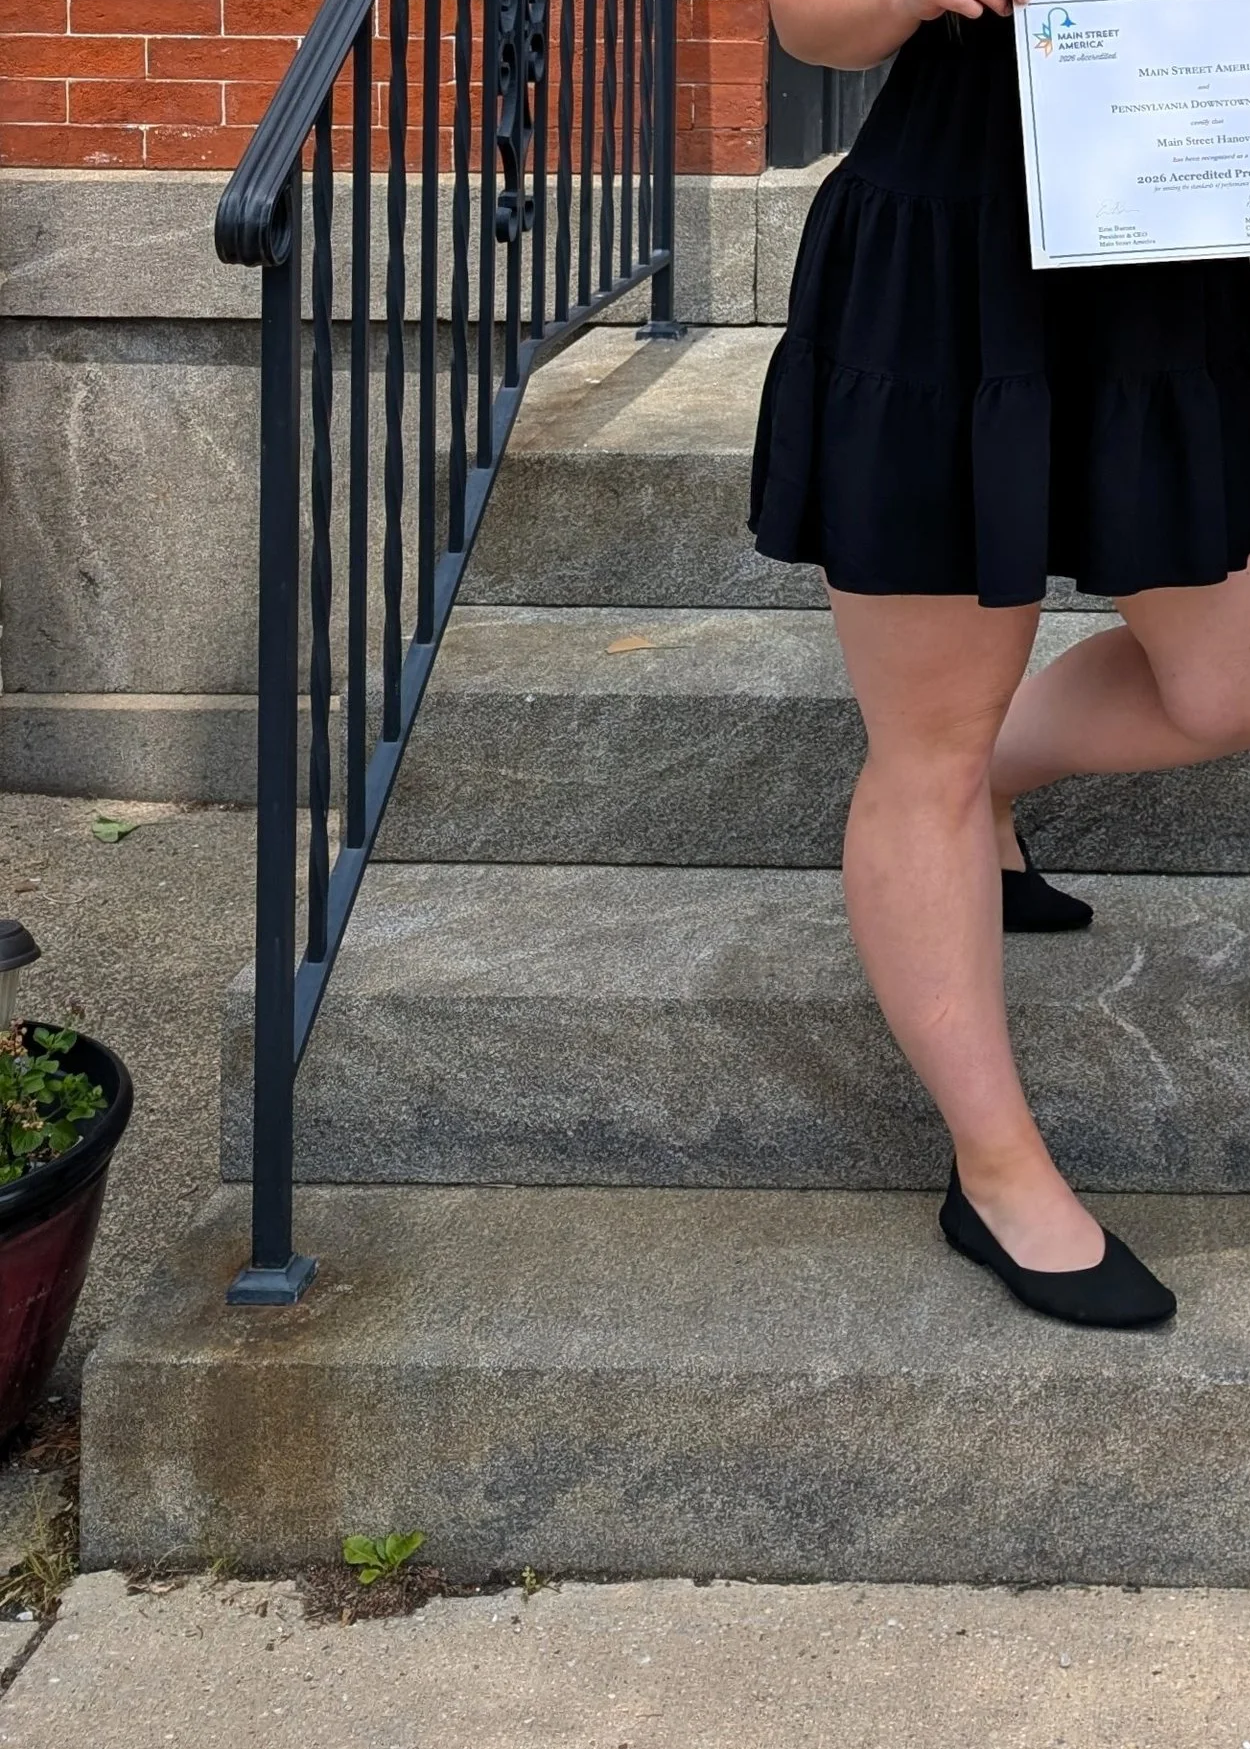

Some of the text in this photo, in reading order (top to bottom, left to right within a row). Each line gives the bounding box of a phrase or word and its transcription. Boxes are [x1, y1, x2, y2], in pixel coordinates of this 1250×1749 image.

[1057, 28, 1119, 41] MAIN STREET
[1058, 39, 1103, 50] AMERICA
[1138, 67, 1169, 77] MAIN
[1171, 65, 1213, 76] STREET
[1110, 101, 1189, 113] PENNSYLVANIA
[1156, 137, 1183, 147] Main
[1185, 136, 1214, 146] Street
[1136, 172, 1167, 184] 2026
[1168, 168, 1232, 182] Accredited
